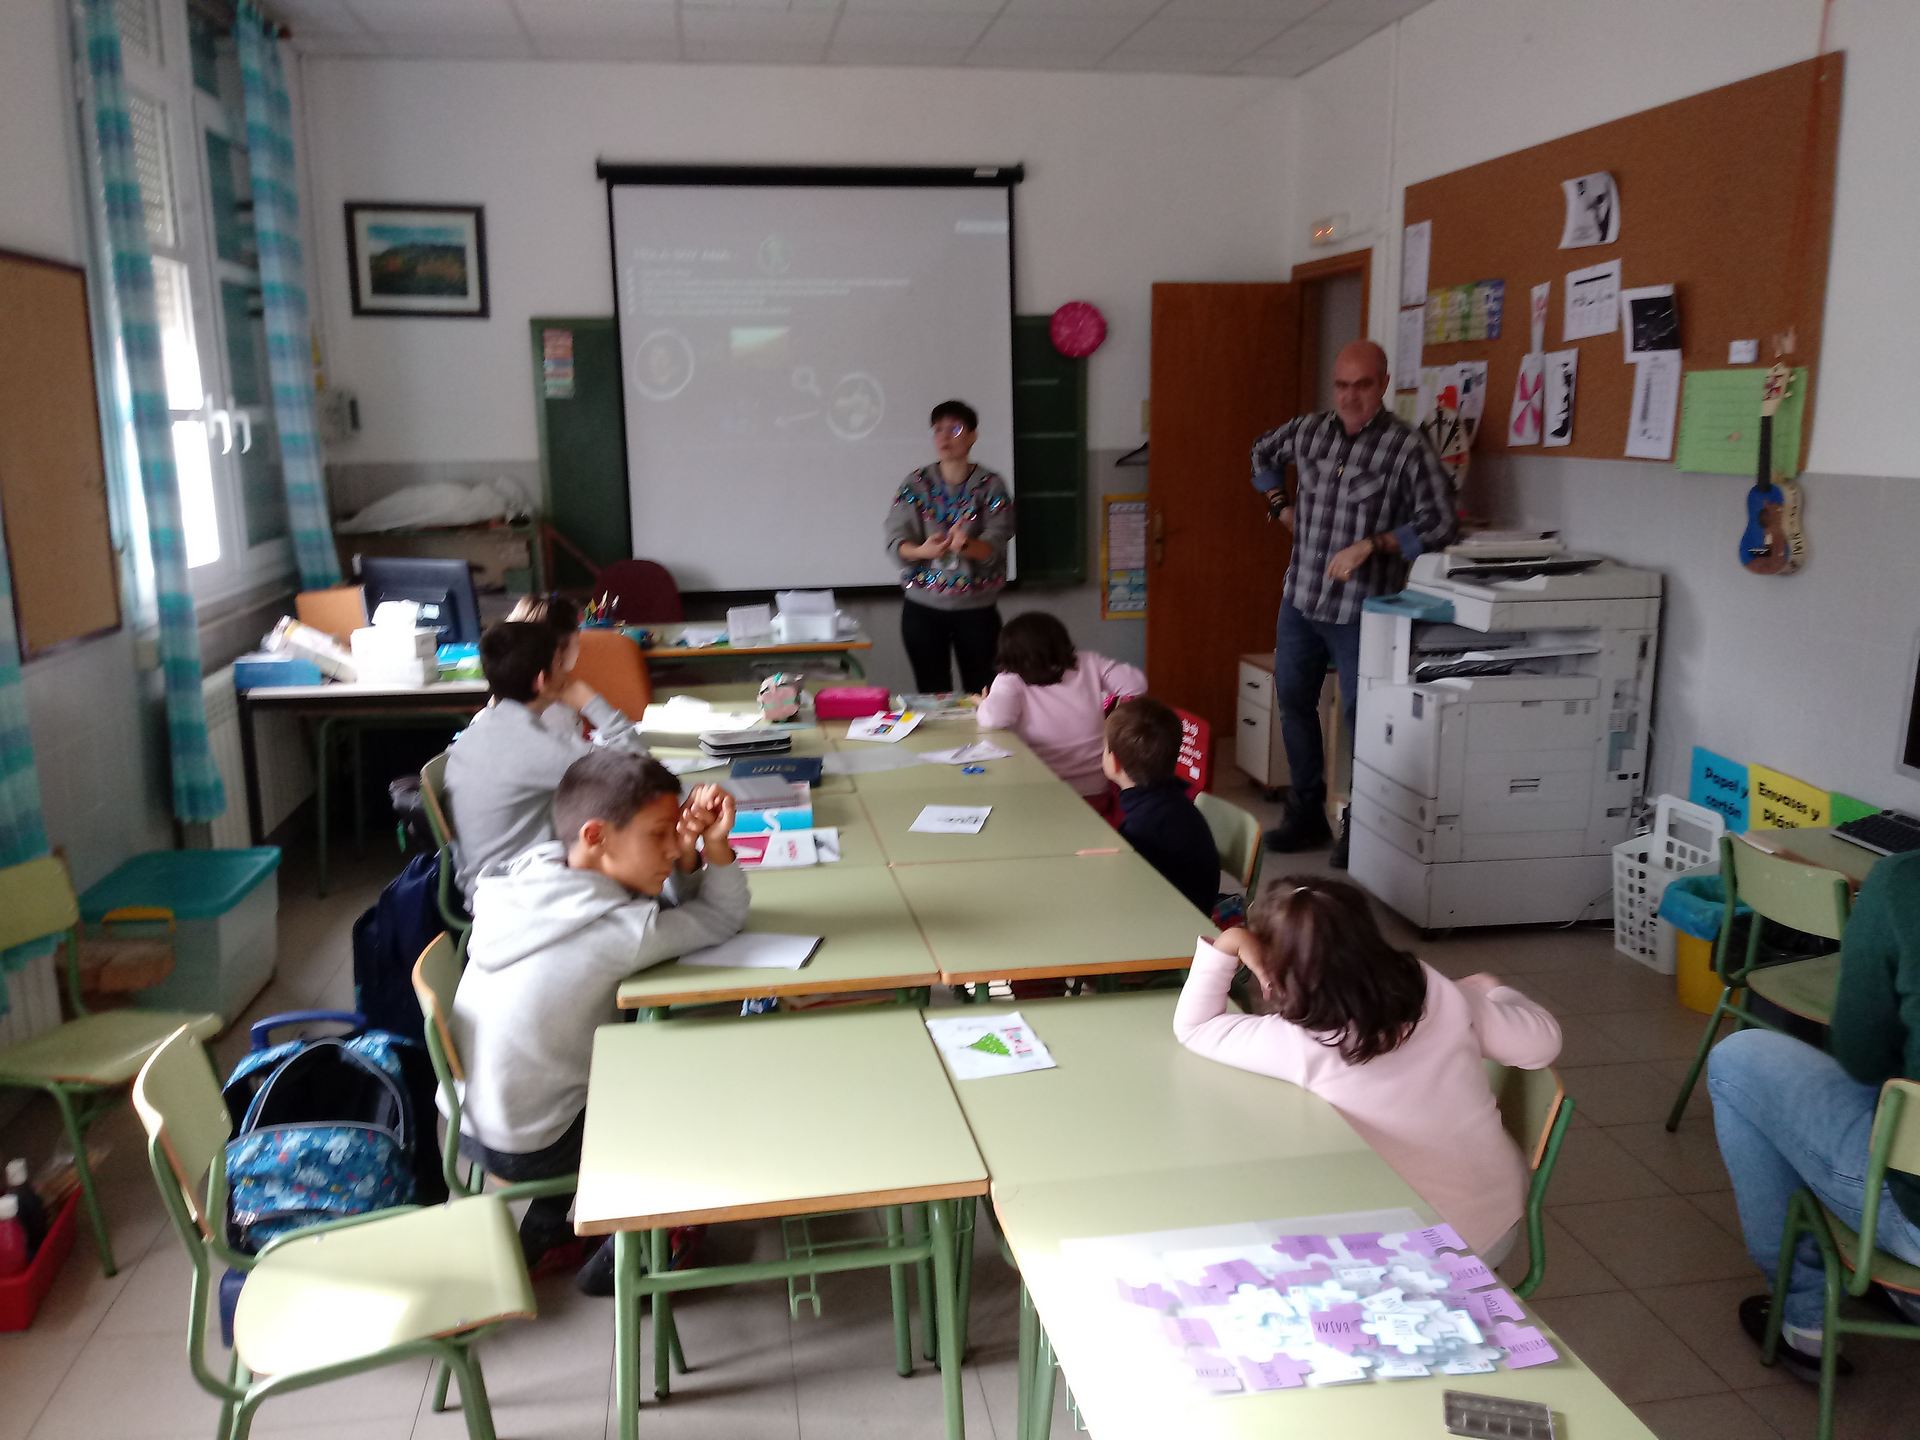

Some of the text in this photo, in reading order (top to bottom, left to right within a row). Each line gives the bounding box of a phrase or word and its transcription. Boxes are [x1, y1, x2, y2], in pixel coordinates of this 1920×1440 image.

[1704, 766, 1749, 800] Papel y
[1758, 781, 1820, 821] Envases y
